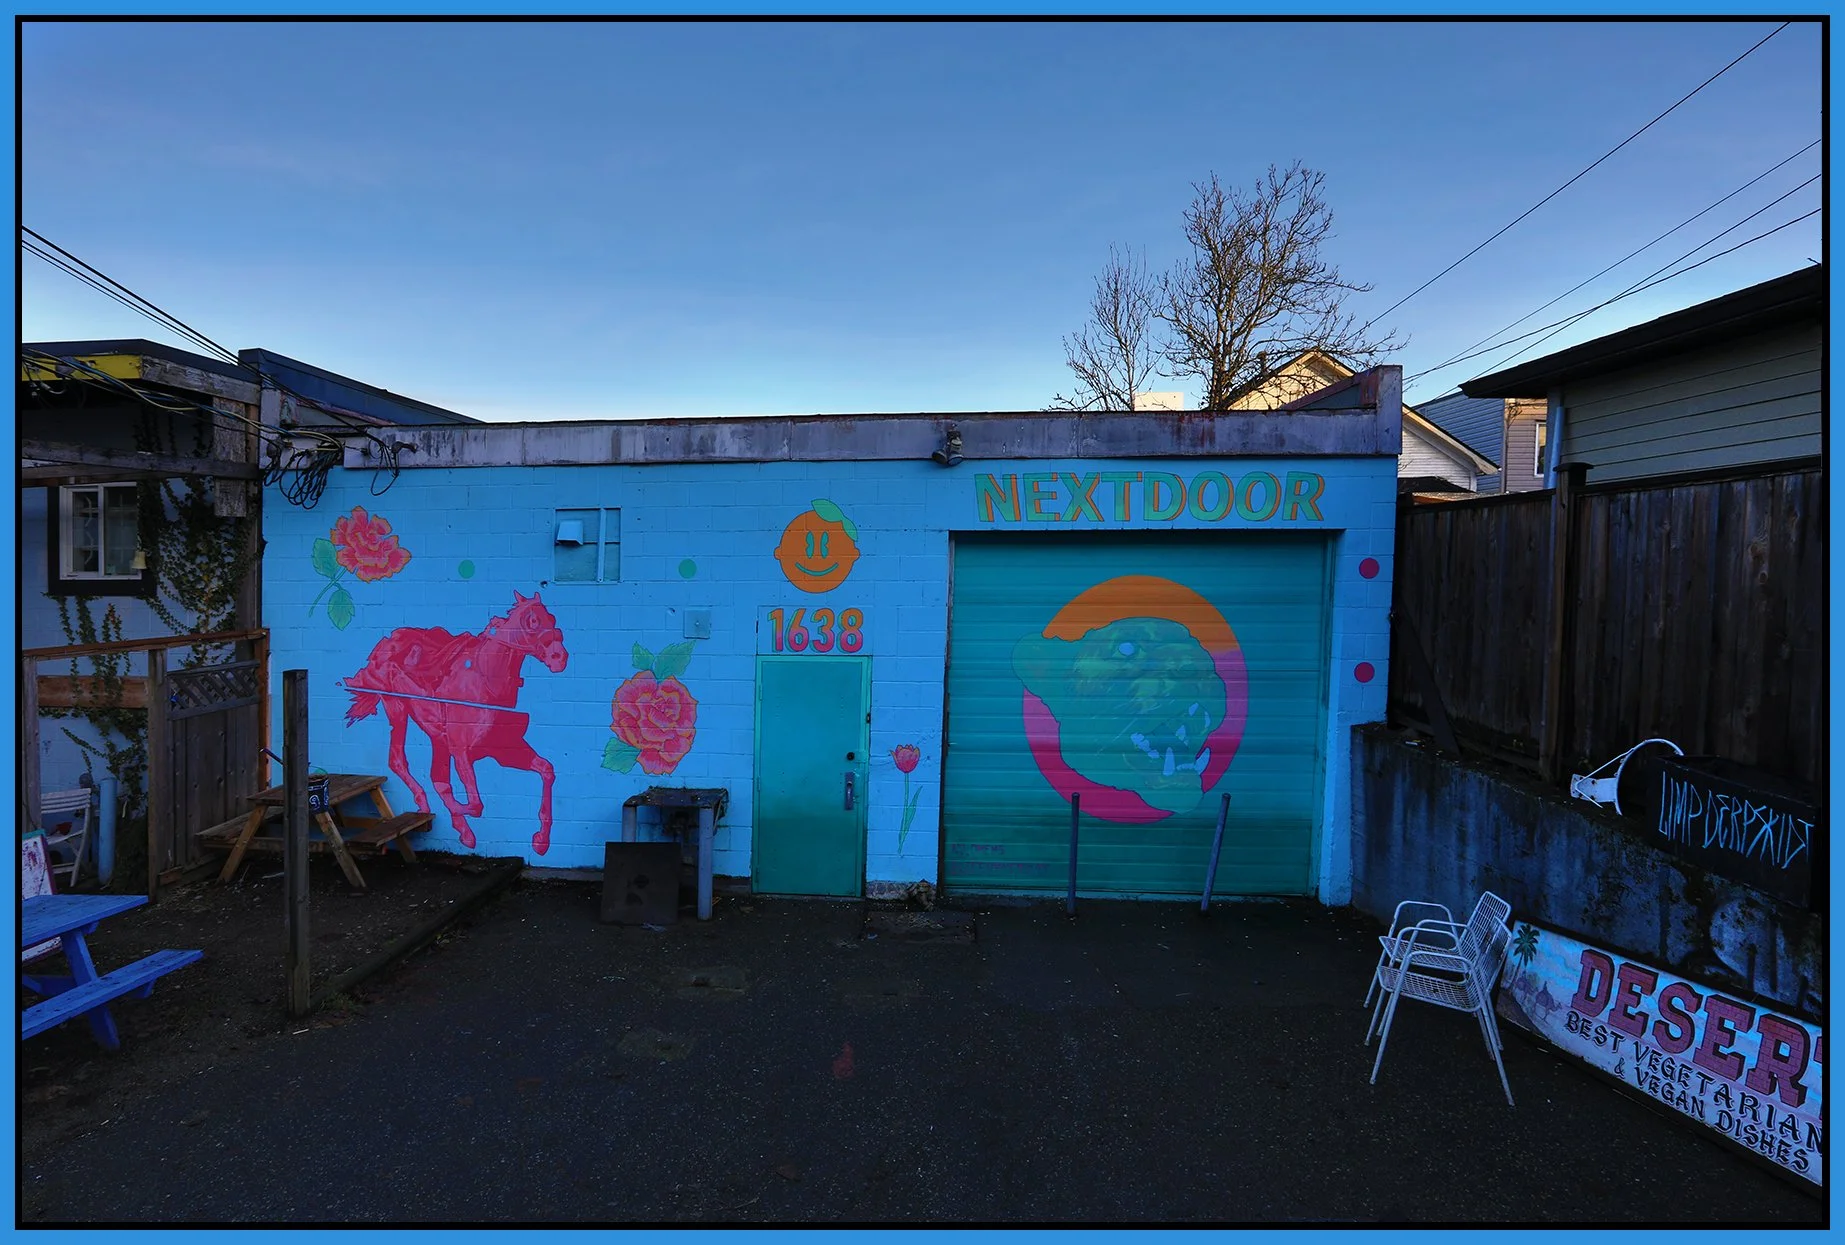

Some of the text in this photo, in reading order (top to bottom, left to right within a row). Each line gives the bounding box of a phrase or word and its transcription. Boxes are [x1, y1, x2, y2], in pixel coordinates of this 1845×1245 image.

[974, 470, 1325, 524] NEXTDOOR
[768, 607, 865, 654] 1638
[1658, 771, 1703, 847] LIMP
[1570, 948, 1823, 1121] DESER
[1565, 1010, 1823, 1158] BEST VEGETARIAN
[1613, 1056, 1811, 1174] & VEGAN DISHES
